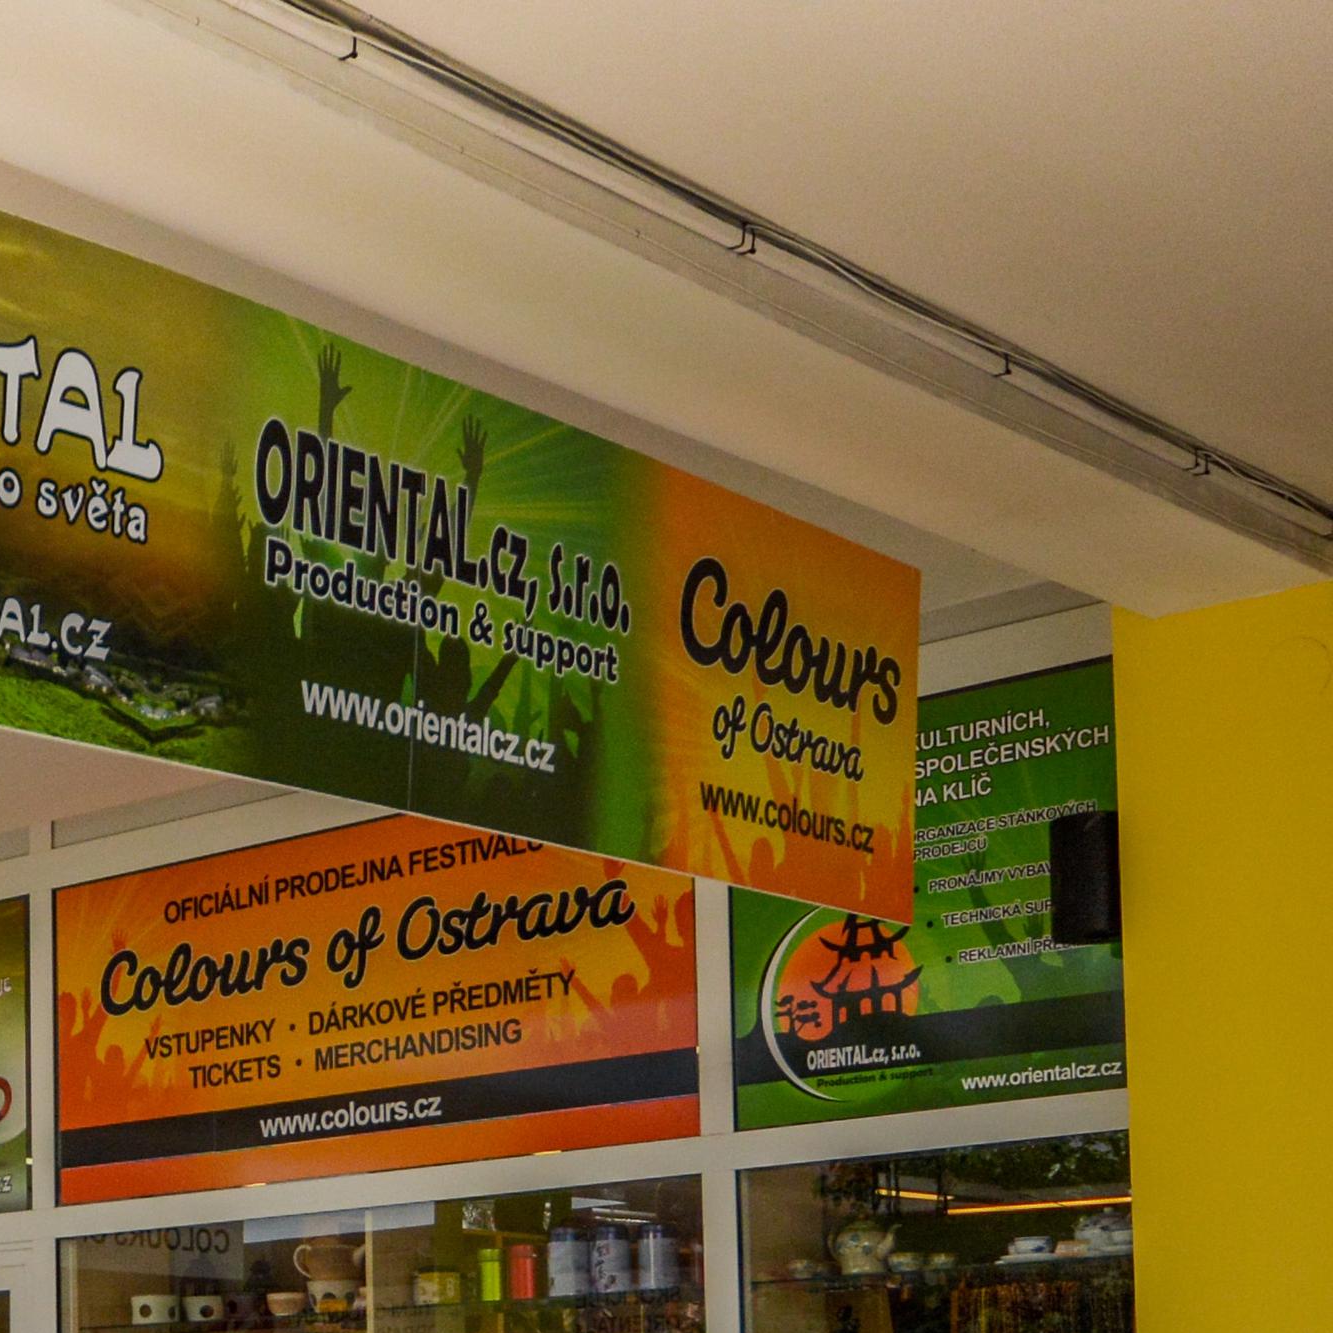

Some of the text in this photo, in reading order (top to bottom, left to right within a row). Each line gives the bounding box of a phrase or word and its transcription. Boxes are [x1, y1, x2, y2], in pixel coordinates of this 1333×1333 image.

[38, 479, 148, 542] světa
[264, 537, 619, 685] Production & support
[548, 541, 632, 635] s.r.o.
[680, 556, 901, 727] Colours
[300, 680, 556, 774] www.orientalcz.cz
[712, 695, 864, 783] of Ostrava
[914, 724, 1109, 780] SPOLEČENSKÝCH
[699, 780, 875, 854] www.colours.cz
[943, 772, 992, 804] KLÍČ
[915, 816, 995, 844] RGANIZACE
[164, 873, 270, 925] OFICIÁLNÍ
[275, 855, 403, 902] PRODEJNA
[929, 869, 1006, 892] PRONÁJMY
[942, 901, 1021, 926] TECHNICKÁ
[100, 878, 635, 1017] Colours of Ostrava
[959, 938, 1031, 963] REKLAMNÍ
[144, 969, 574, 1060] VSTUPENKY DÁRKOVÉ PŘEDMĚTY
[189, 1019, 523, 1089] TICKETS MERCHANDISING
[891, 1044, 921, 1061] s.r.o.
[962, 1061, 1122, 1092] www.orientalcz.cz
[259, 1095, 442, 1139] www.colours.cz
